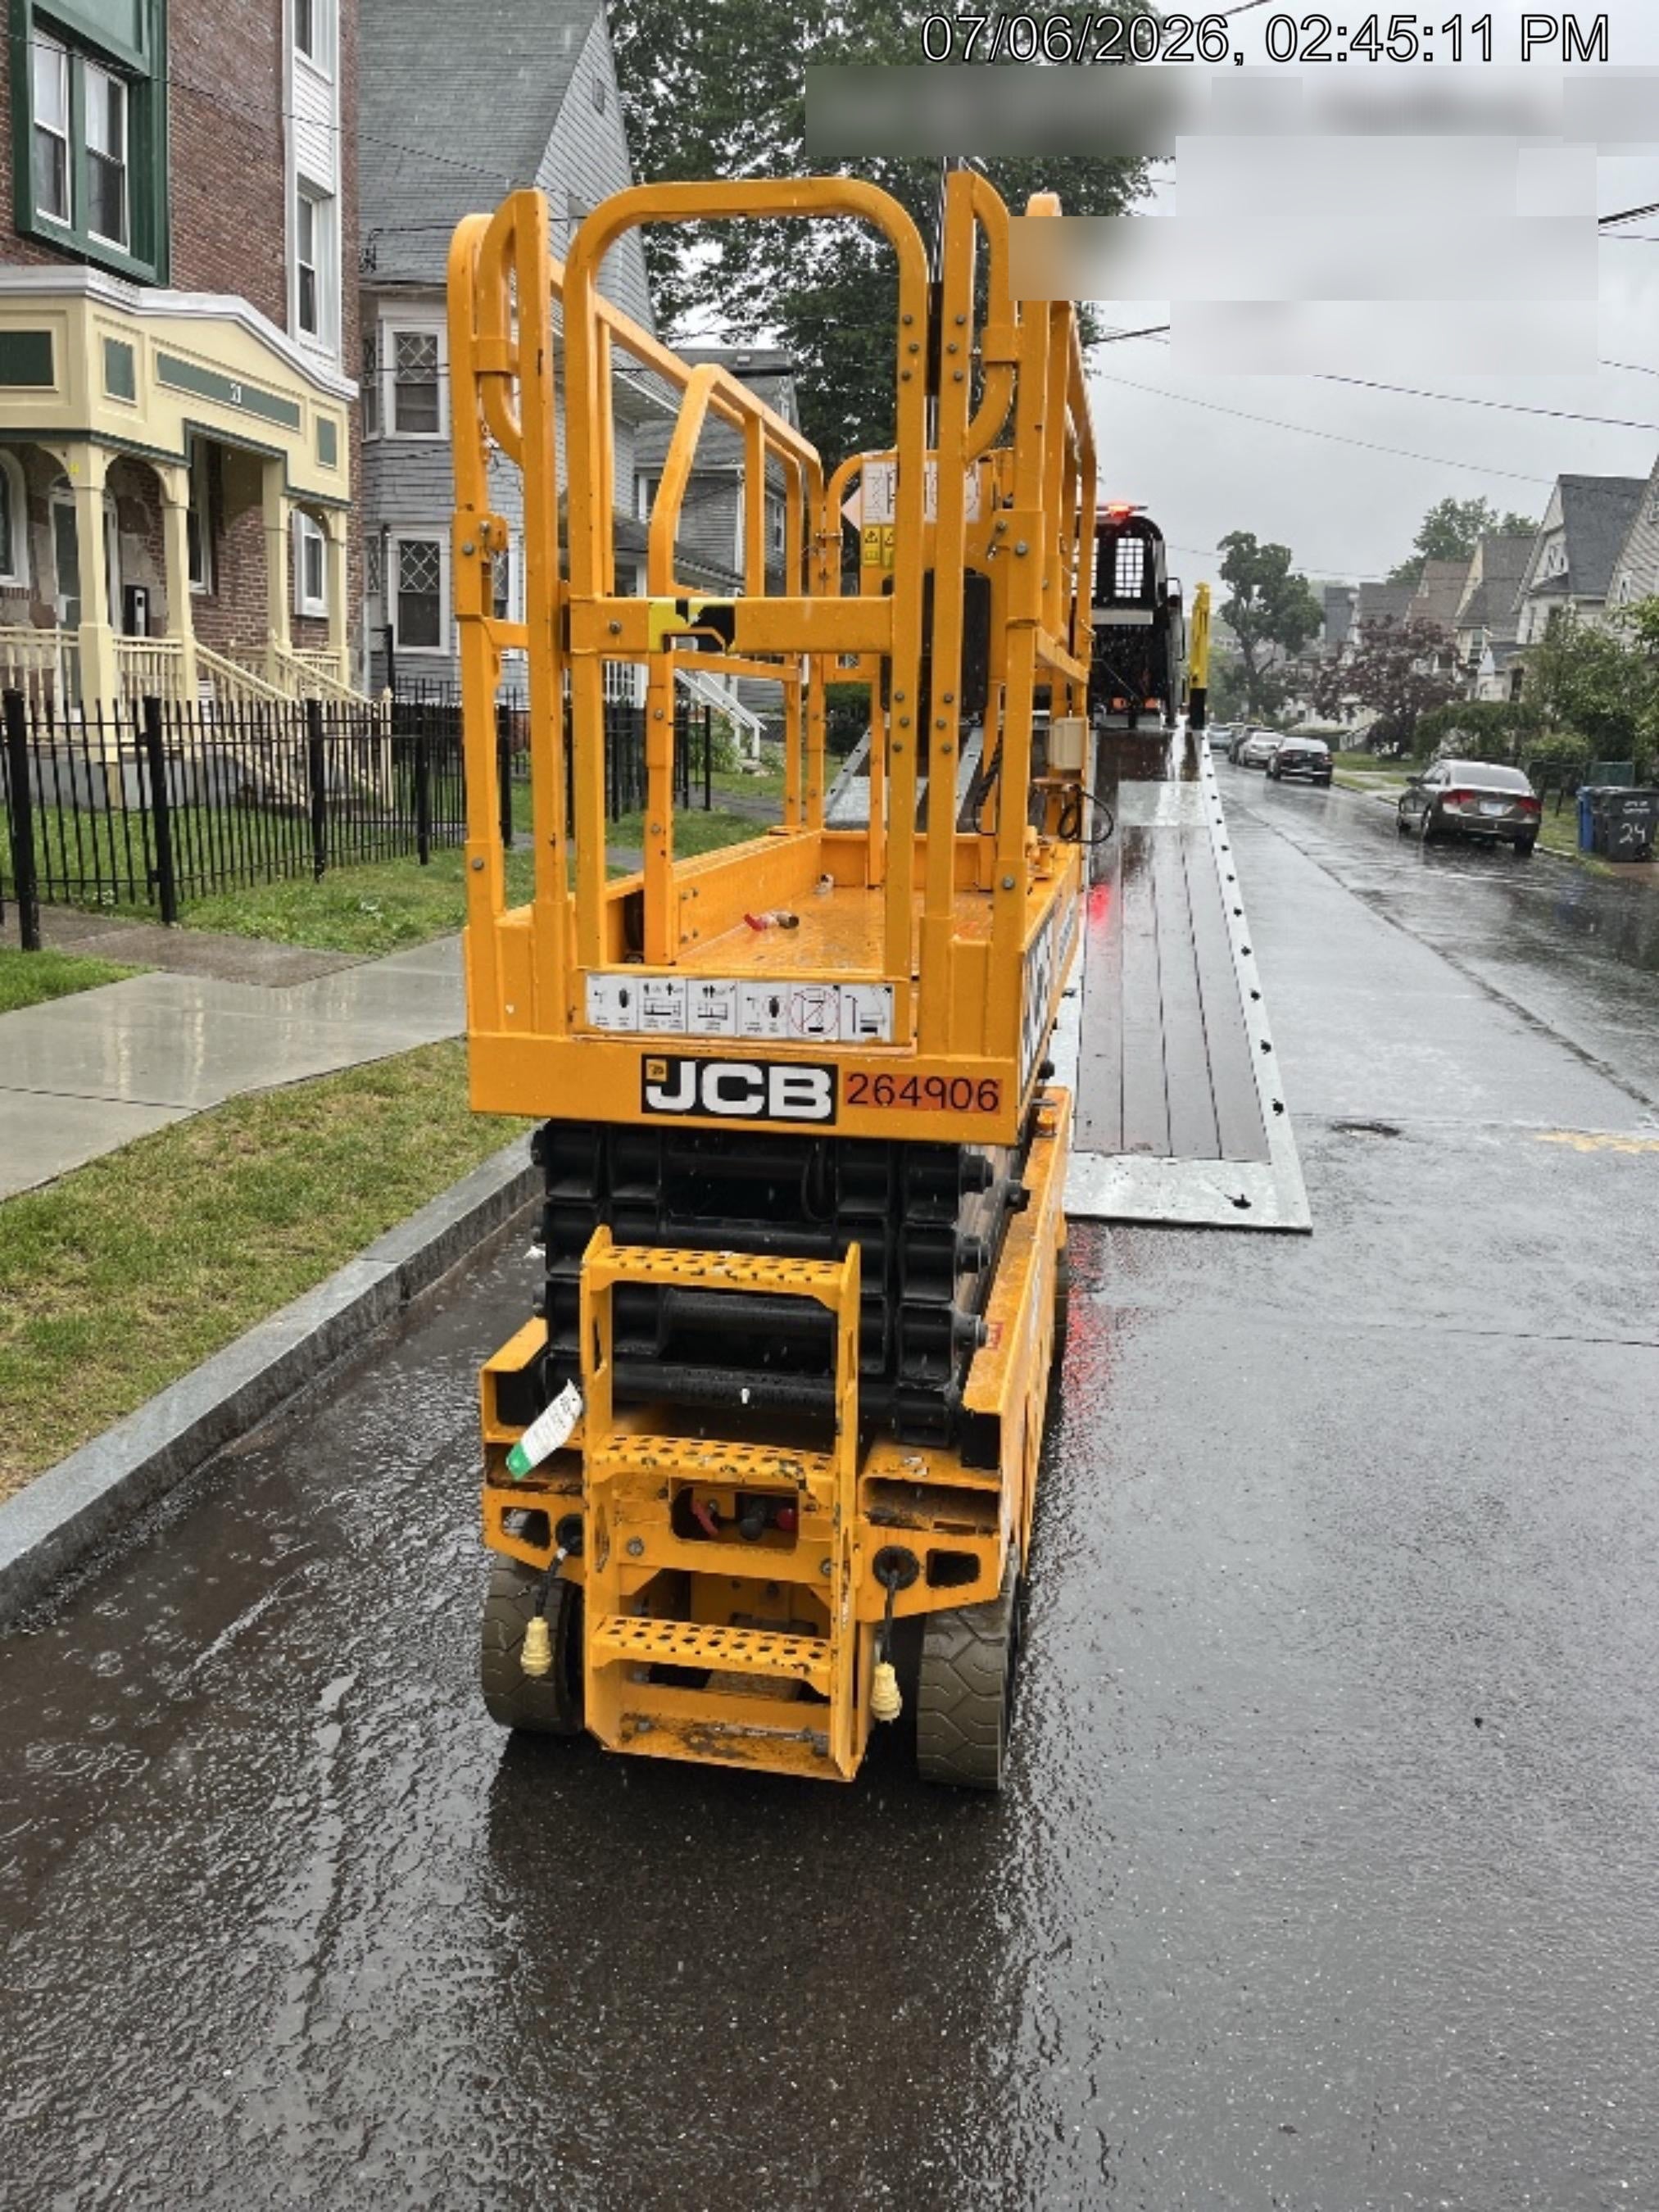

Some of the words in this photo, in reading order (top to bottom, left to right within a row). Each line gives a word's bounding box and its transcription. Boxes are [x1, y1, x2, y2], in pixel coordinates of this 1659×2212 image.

[1619, 822, 1647, 845] 24
[646, 1060, 832, 1120] JCB
[847, 1072, 1000, 1113] 264906
